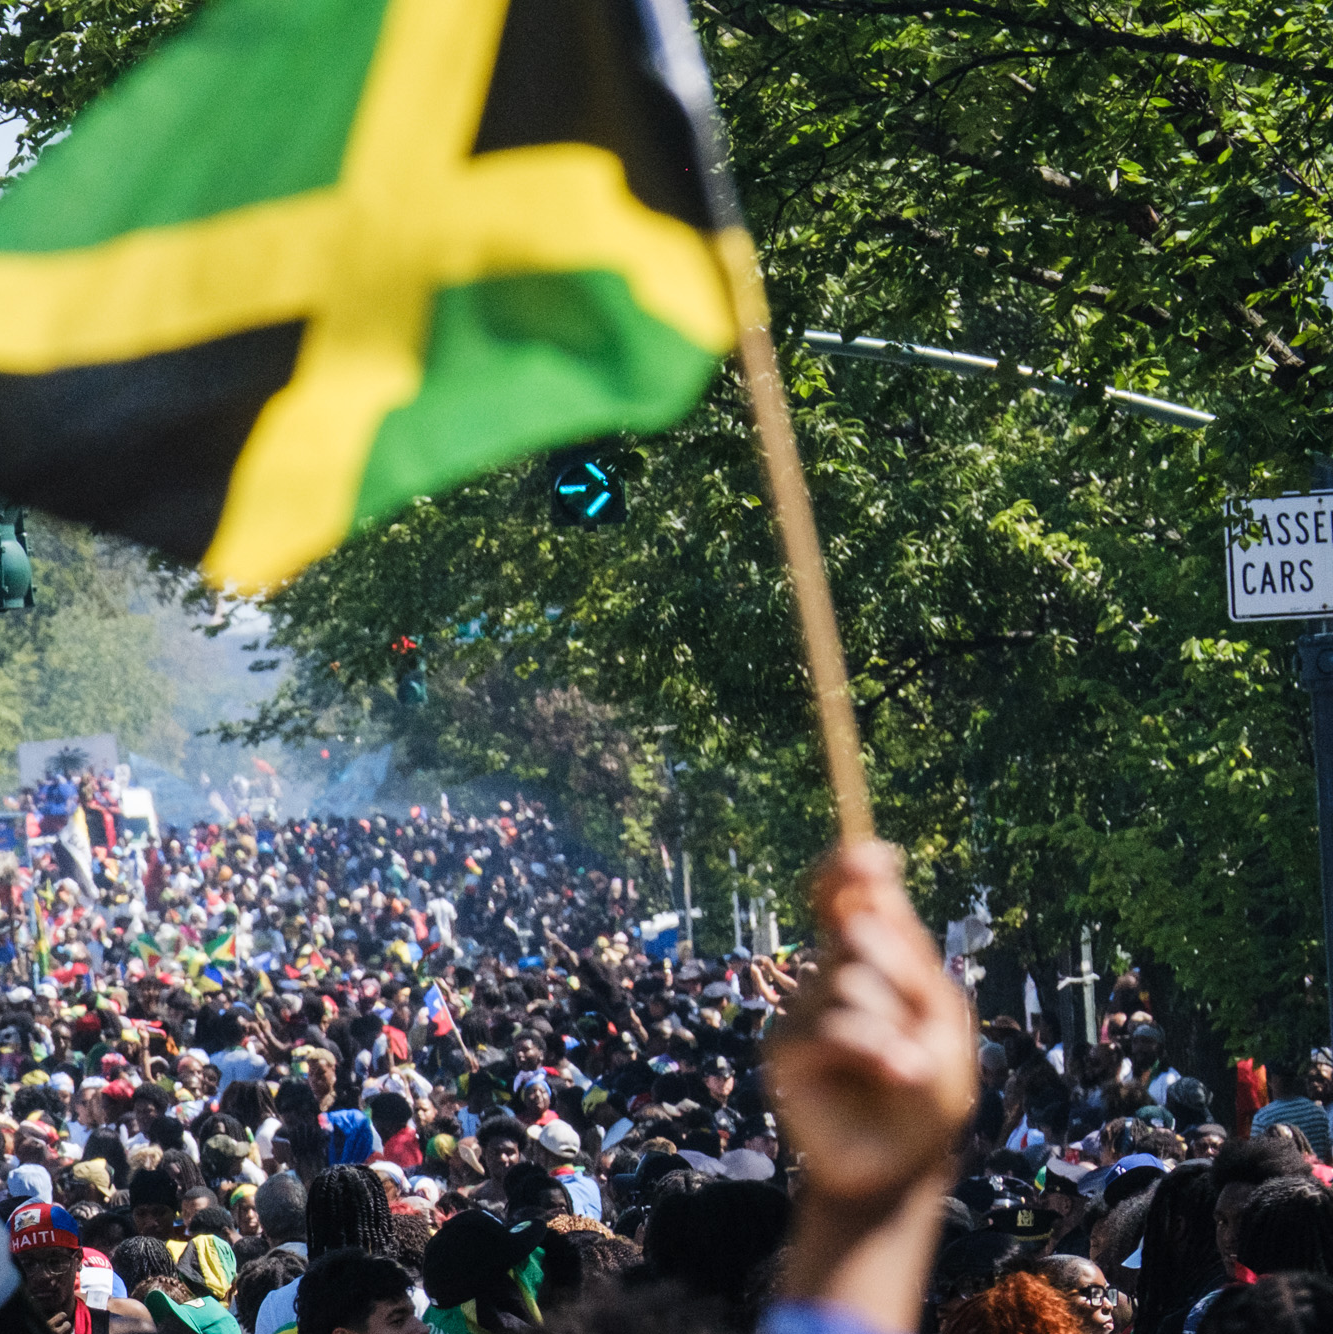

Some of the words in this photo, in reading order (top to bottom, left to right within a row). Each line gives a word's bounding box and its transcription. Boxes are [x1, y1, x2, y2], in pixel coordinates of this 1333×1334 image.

[1240, 508, 1333, 547] ASSE
[1242, 559, 1314, 595] CARS
[11, 1230, 56, 1251] HAITI
